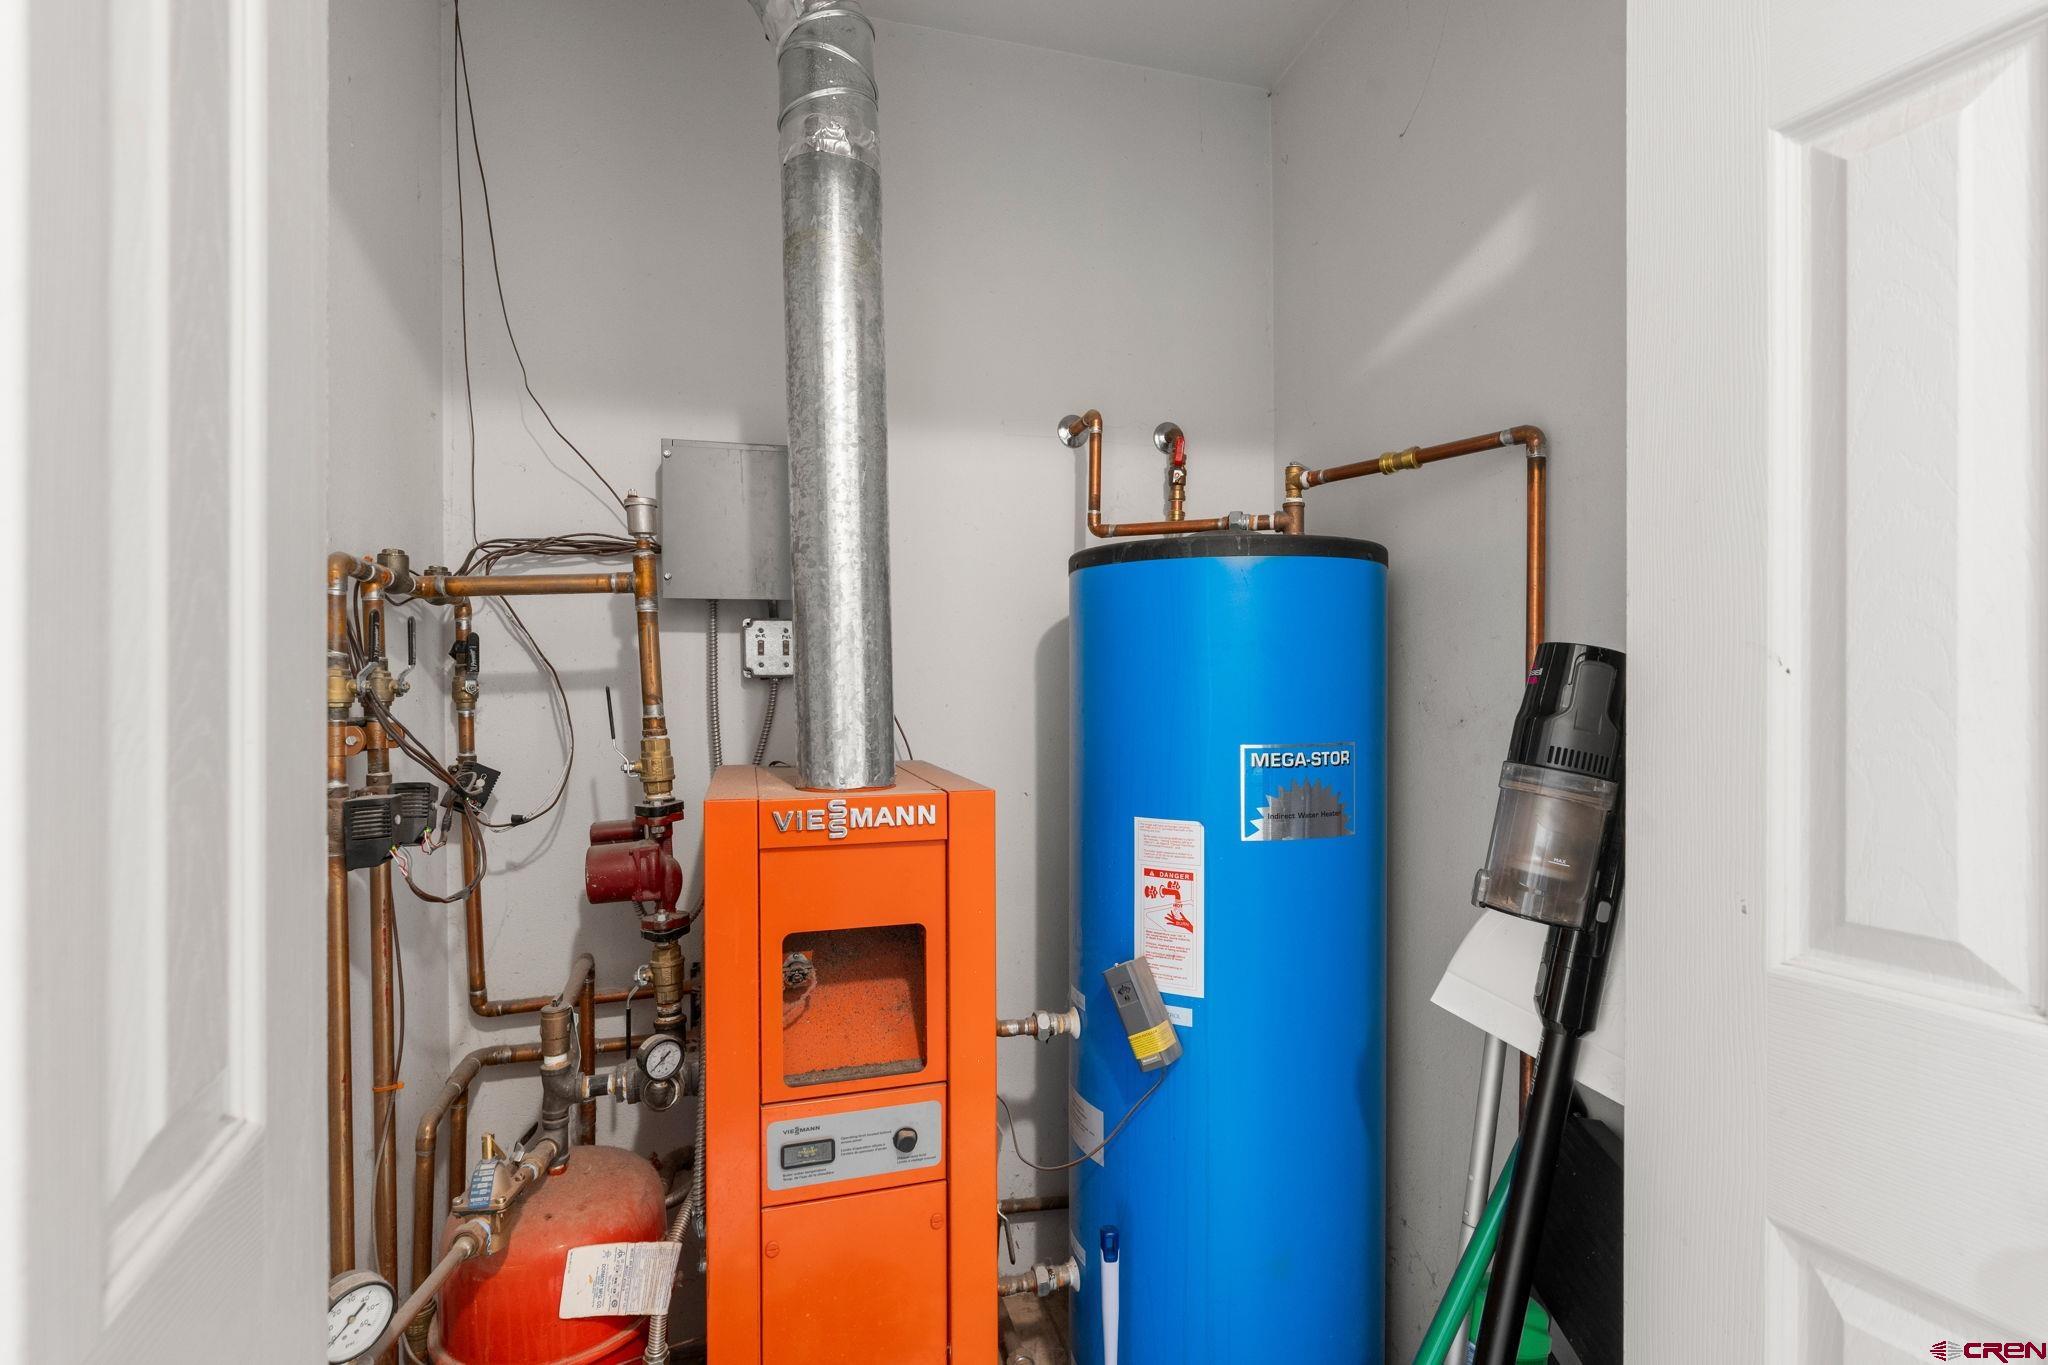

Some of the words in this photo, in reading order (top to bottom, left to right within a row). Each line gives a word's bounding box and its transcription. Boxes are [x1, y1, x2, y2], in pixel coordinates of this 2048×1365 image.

[1251, 750, 1351, 768] MEGA-STOR
[772, 799, 936, 839] VIESSMANN
[1267, 812, 1296, 820] Indirect
[1297, 811, 1319, 819] Water
[1320, 809, 1342, 818] Heater
[1553, 857, 1568, 865] MAX
[1159, 871, 1190, 880] DANGER
[782, 1125, 821, 1136] VIESSMANN
[366, 1304, 375, 1312] 50
[360, 1319, 368, 1327] 60
